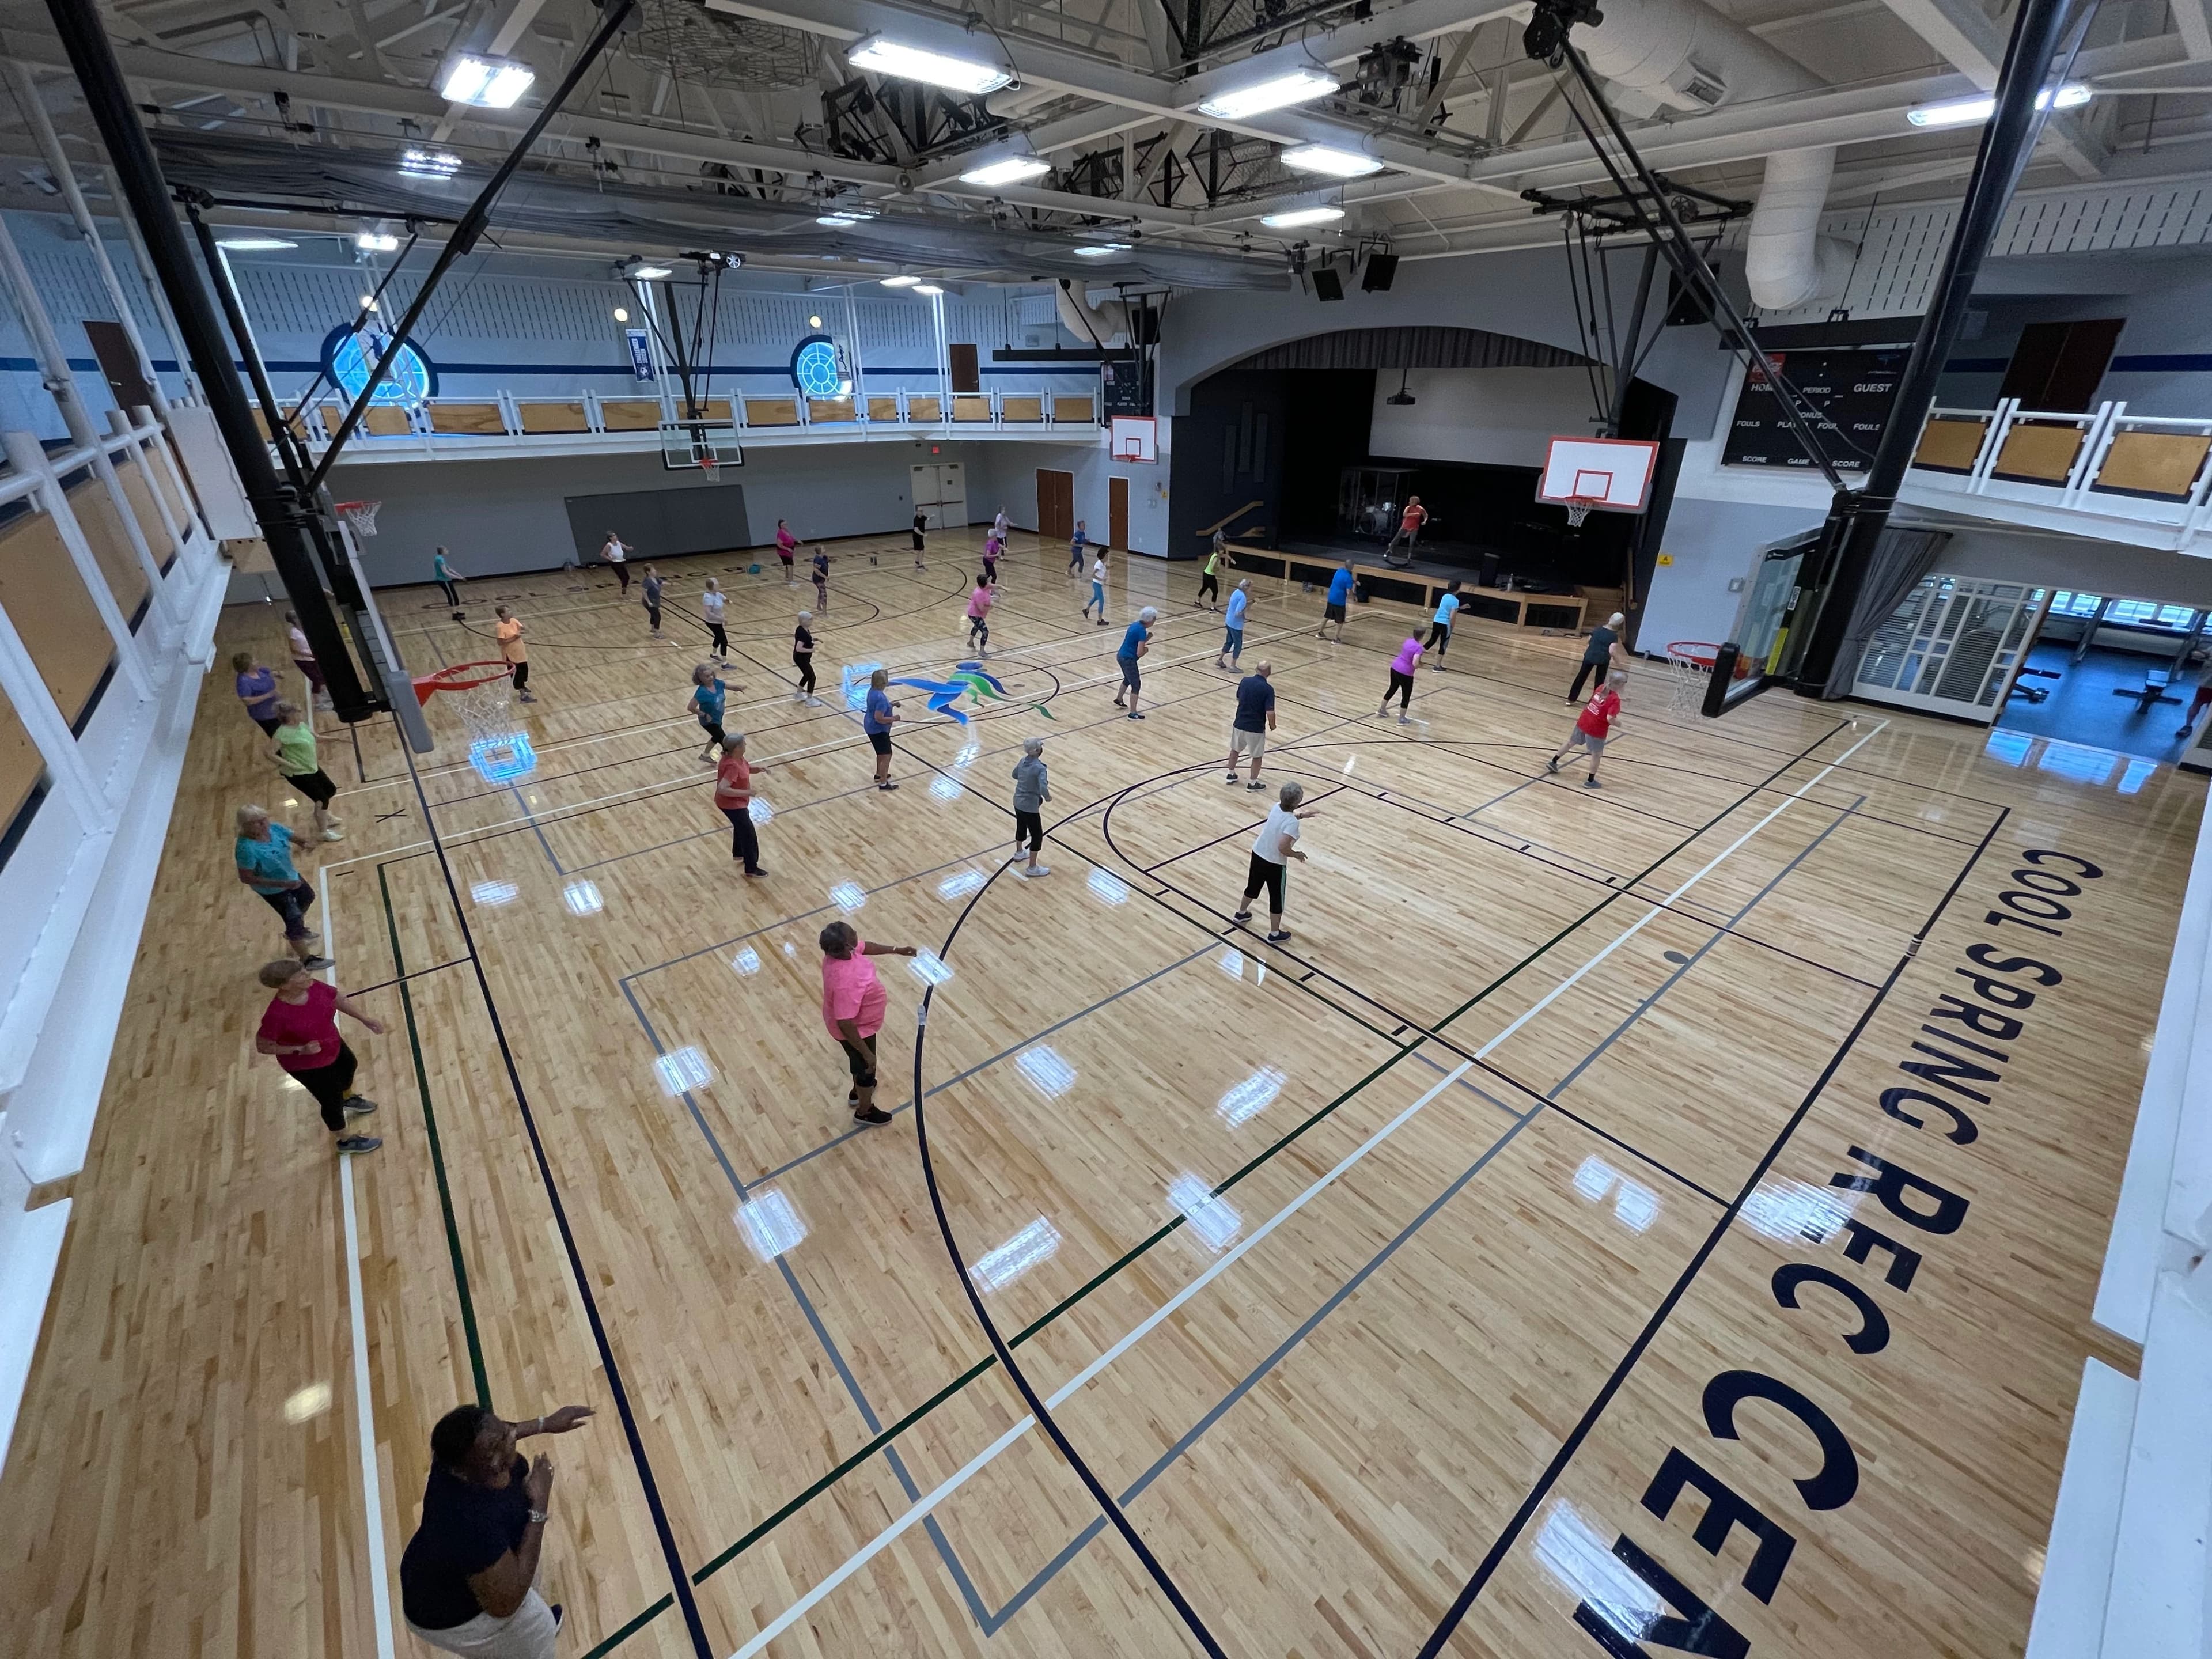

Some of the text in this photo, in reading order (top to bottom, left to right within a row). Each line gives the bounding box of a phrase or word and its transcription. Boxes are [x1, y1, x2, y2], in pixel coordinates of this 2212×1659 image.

[1751, 384, 1775, 392] HOM
[1853, 383, 1893, 393] GUEST
[1853, 423, 1881, 431] FOULS
[1983, 849, 2103, 937] COOL
[1879, 944, 2063, 1145] SPRING
[1771, 1145, 1971, 1354] REC
